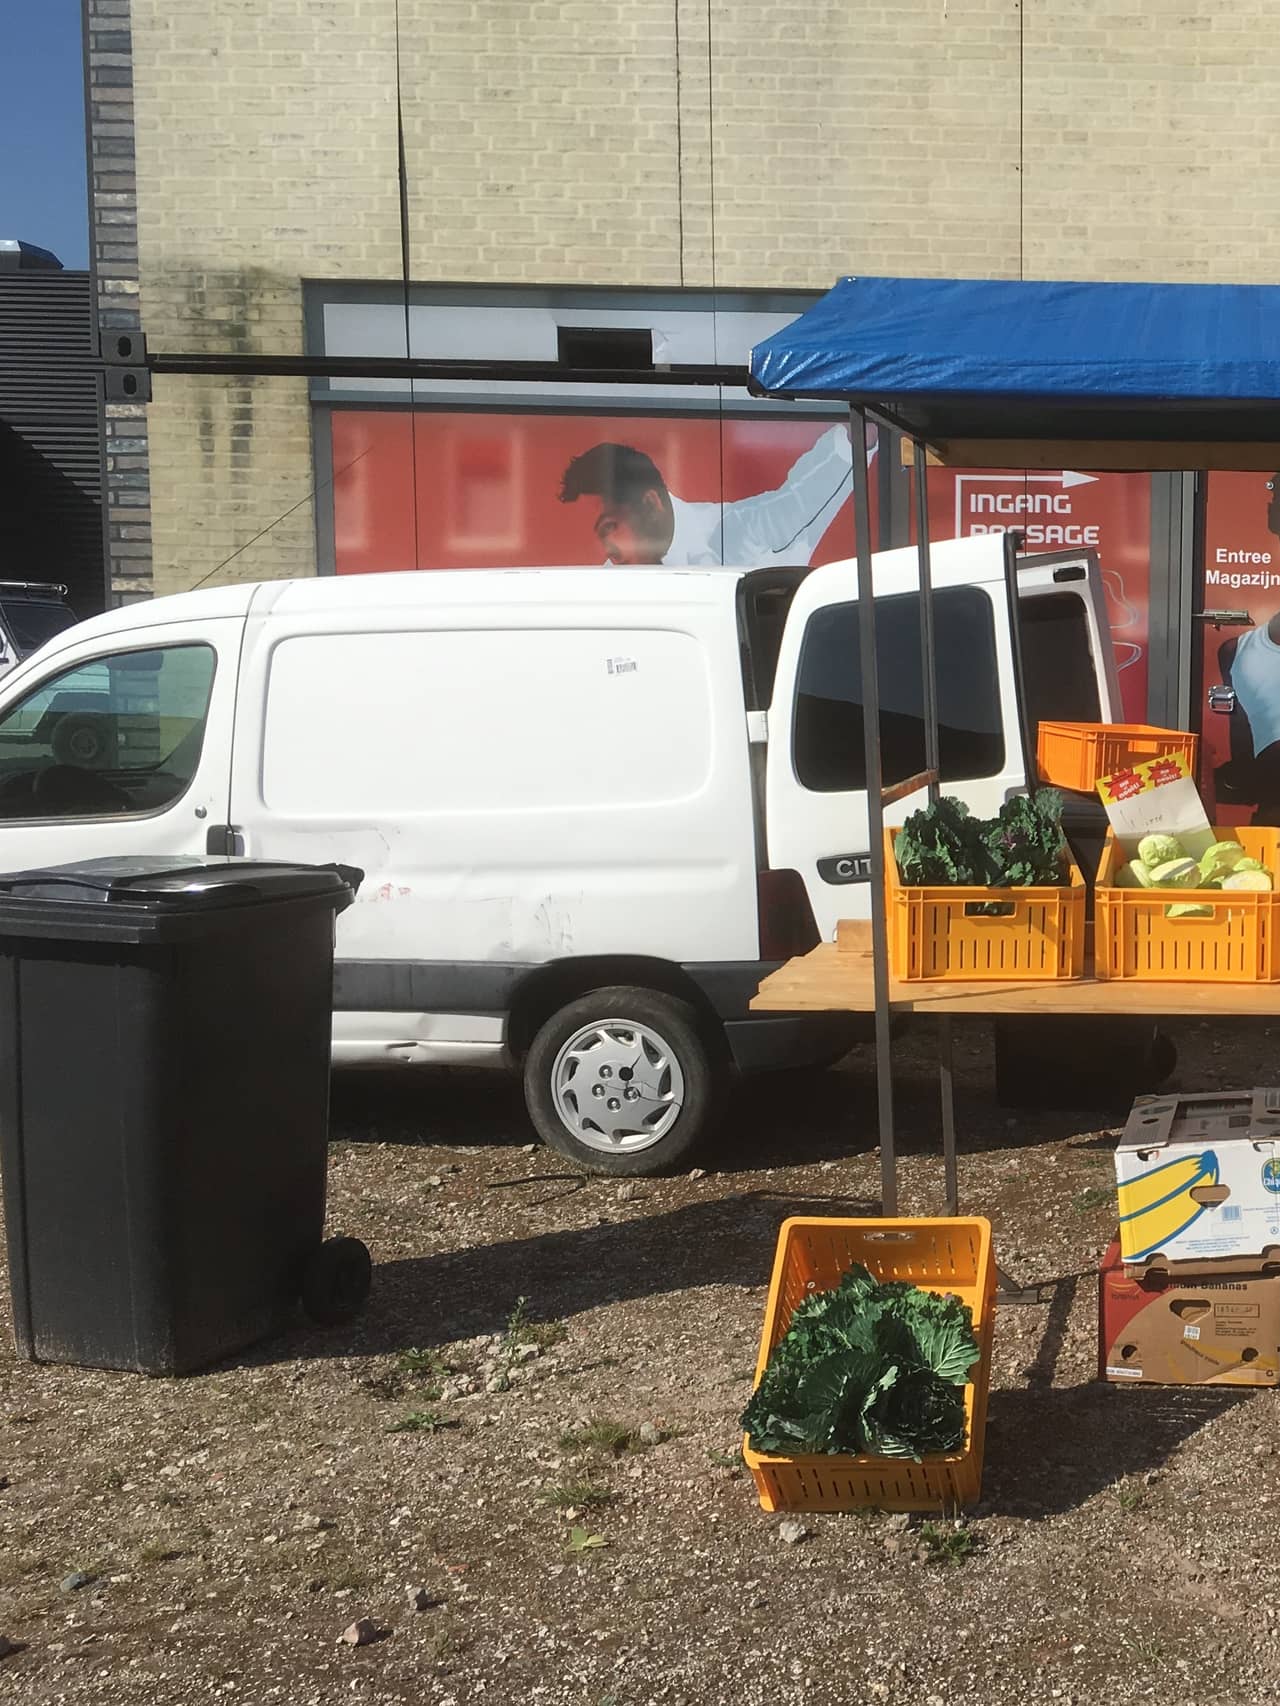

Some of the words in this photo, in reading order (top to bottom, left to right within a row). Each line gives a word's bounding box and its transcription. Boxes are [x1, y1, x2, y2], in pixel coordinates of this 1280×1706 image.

[970, 494, 1072, 514] INGANG
[1216, 548, 1272, 564] Entree
[1205, 569, 1280, 589] Magazijn
[836, 859, 872, 877] CIT
